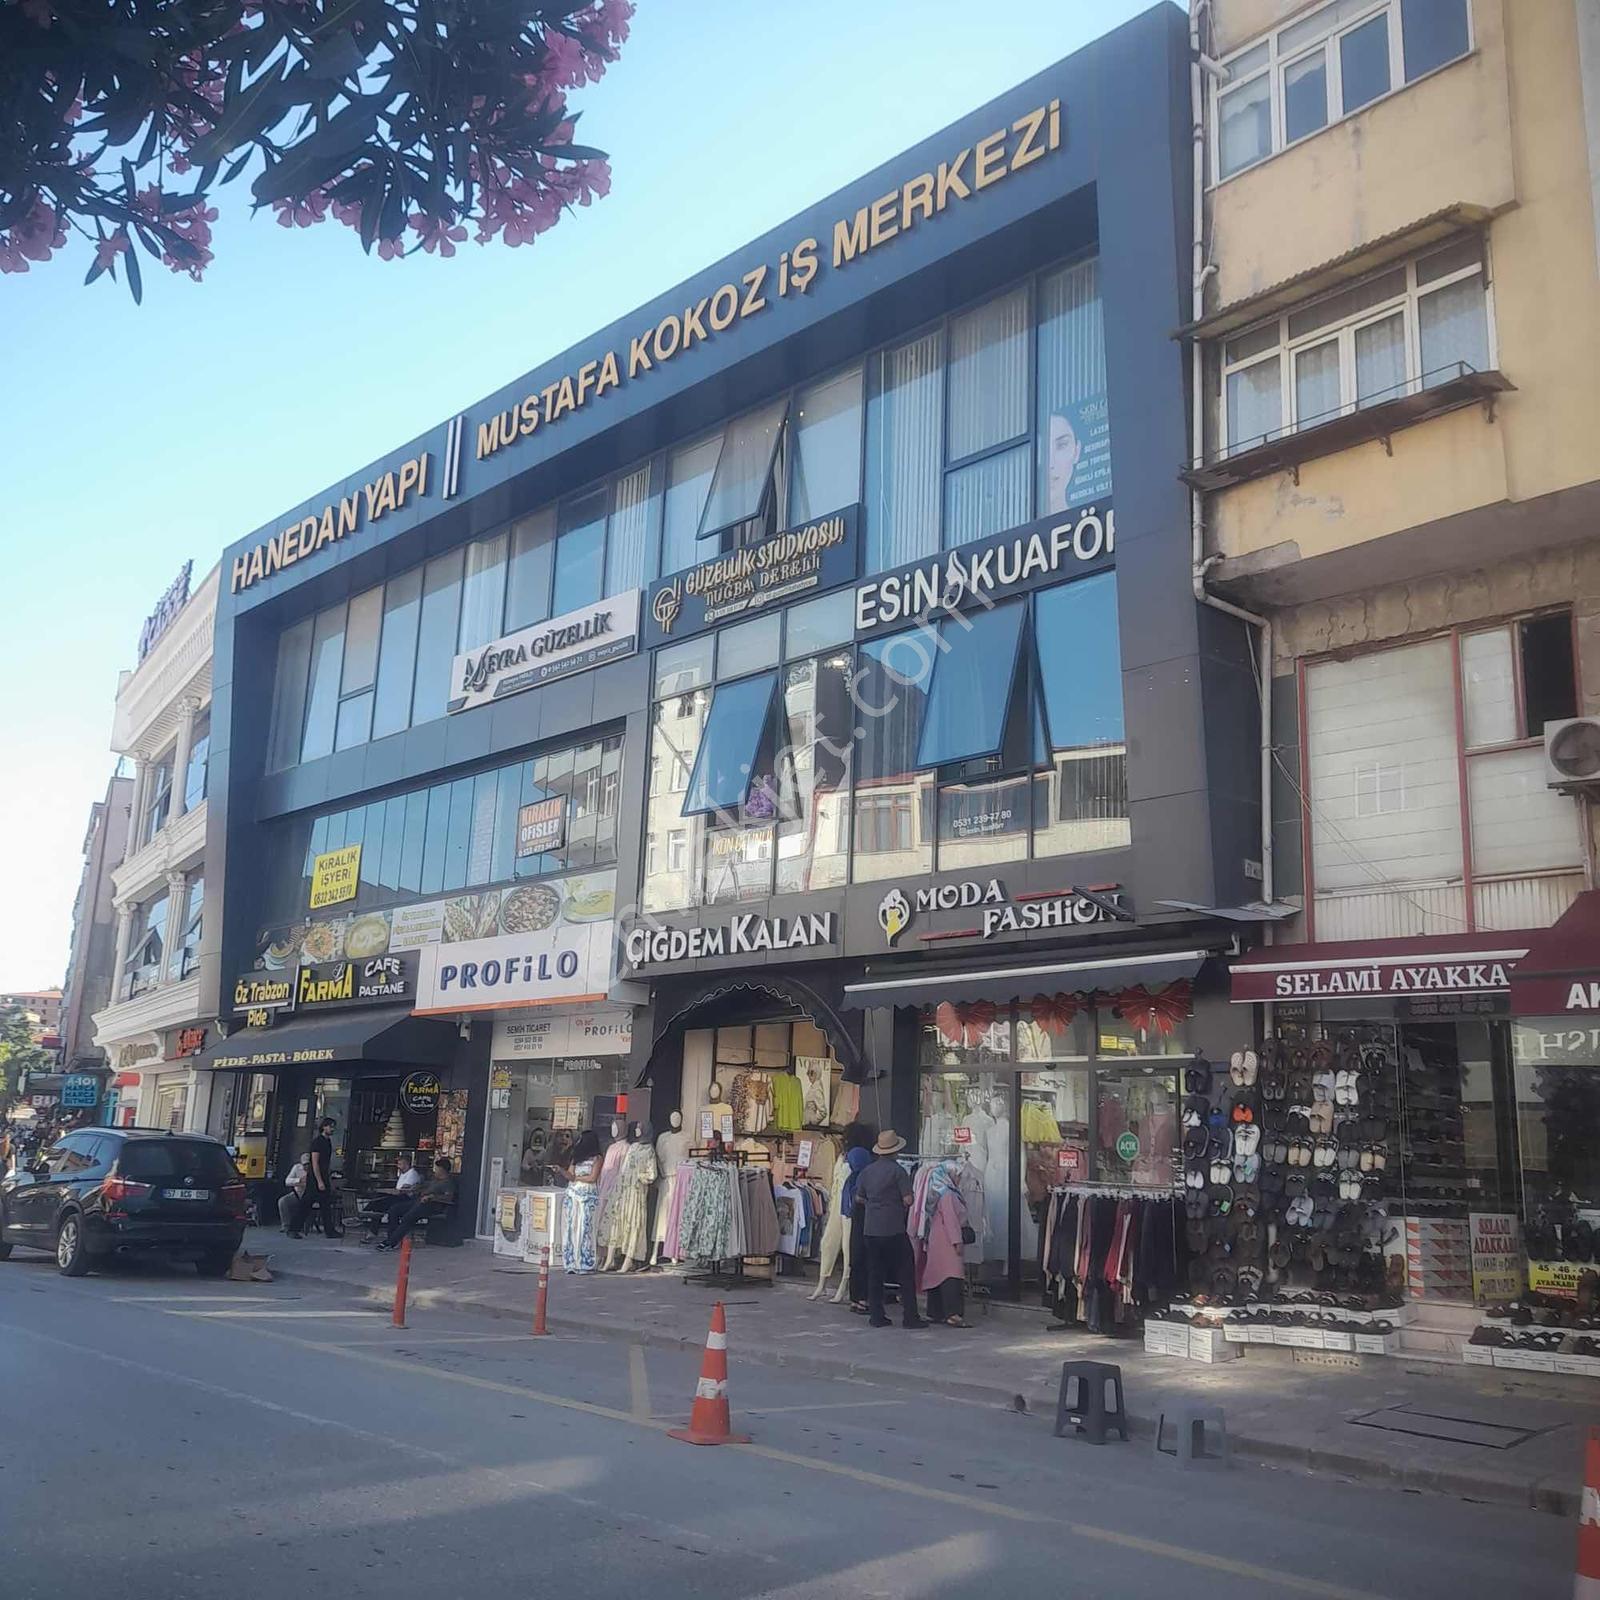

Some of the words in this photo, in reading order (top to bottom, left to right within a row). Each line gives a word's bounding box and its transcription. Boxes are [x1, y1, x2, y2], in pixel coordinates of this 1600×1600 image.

[477, 351, 620, 460] MUSTAFA
[629, 265, 768, 379] KOKOZ
[231, 491, 361, 594] HANEDAN
[364, 453, 428, 522] YAPI
[756, 516, 845, 569] STÜDYOSU
[704, 578, 755, 608] TUĞBA
[462, 645, 527, 692] MEYRA
[531, 611, 613, 657] GÜZELLİK
[915, 878, 1005, 912] MODA
[730, 911, 832, 954] KALAN
[364, 957, 401, 977] CAFE
[1275, 964, 1382, 996] SELAMİ
[1390, 961, 1516, 991] AYAKKA
[234, 979, 249, 1005] Öz
[250, 979, 289, 1002] Trabzon
[299, 964, 353, 1003] FARMA
[358, 981, 404, 997] PASTANE
[247, 1008, 269, 1027] Pide
[1120, 1142, 1137, 1154] AÇIK
[1538, 1264, 1550, 1272] 45
[1553, 1273, 1582, 1281] NUMA
[1536, 1279, 1575, 1288] AYAKKABI
